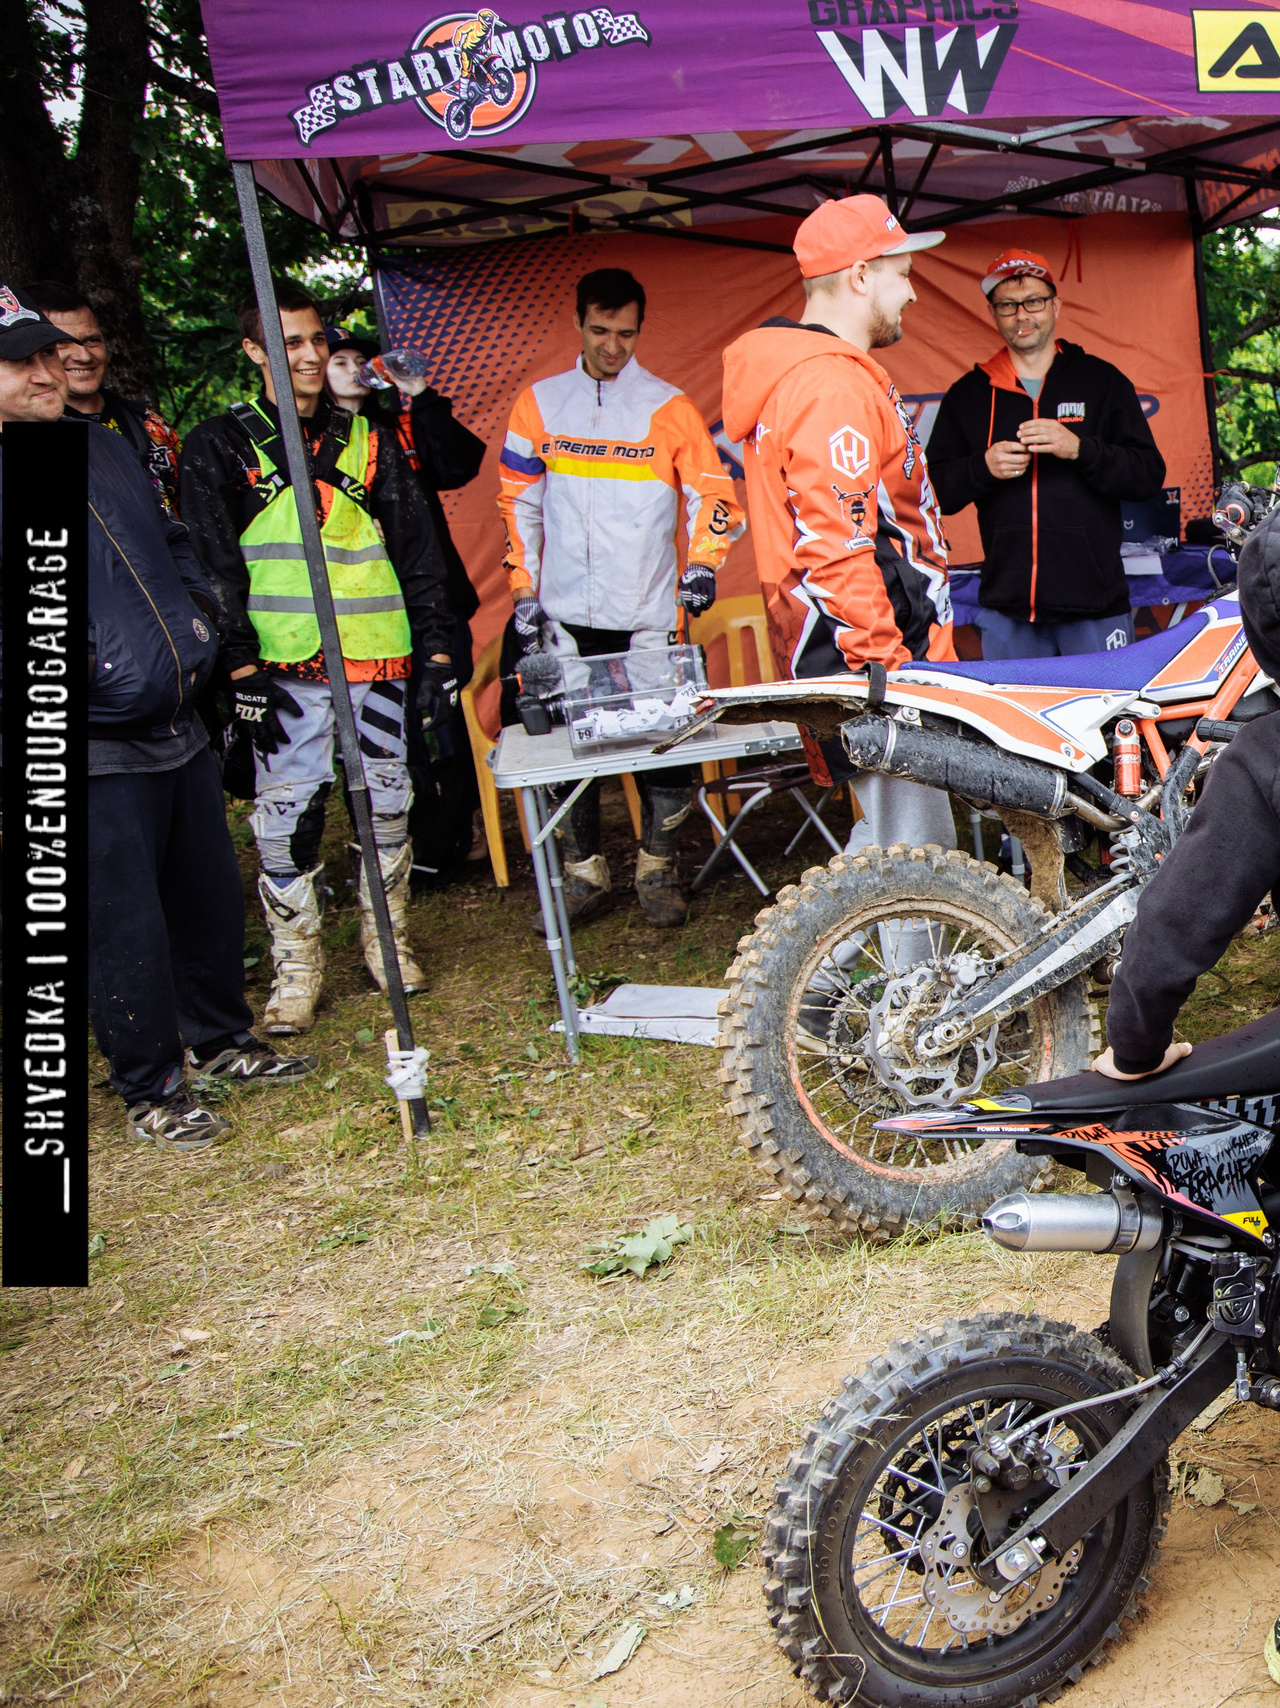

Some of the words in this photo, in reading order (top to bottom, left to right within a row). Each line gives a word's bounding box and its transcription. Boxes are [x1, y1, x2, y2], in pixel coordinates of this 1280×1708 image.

[333, 47, 461, 111] START
[490, 12, 600, 72] MOTO
[541, 437, 608, 460] EXTREME
[611, 445, 656, 460] MOTO
[235, 703, 268, 723] FOX
